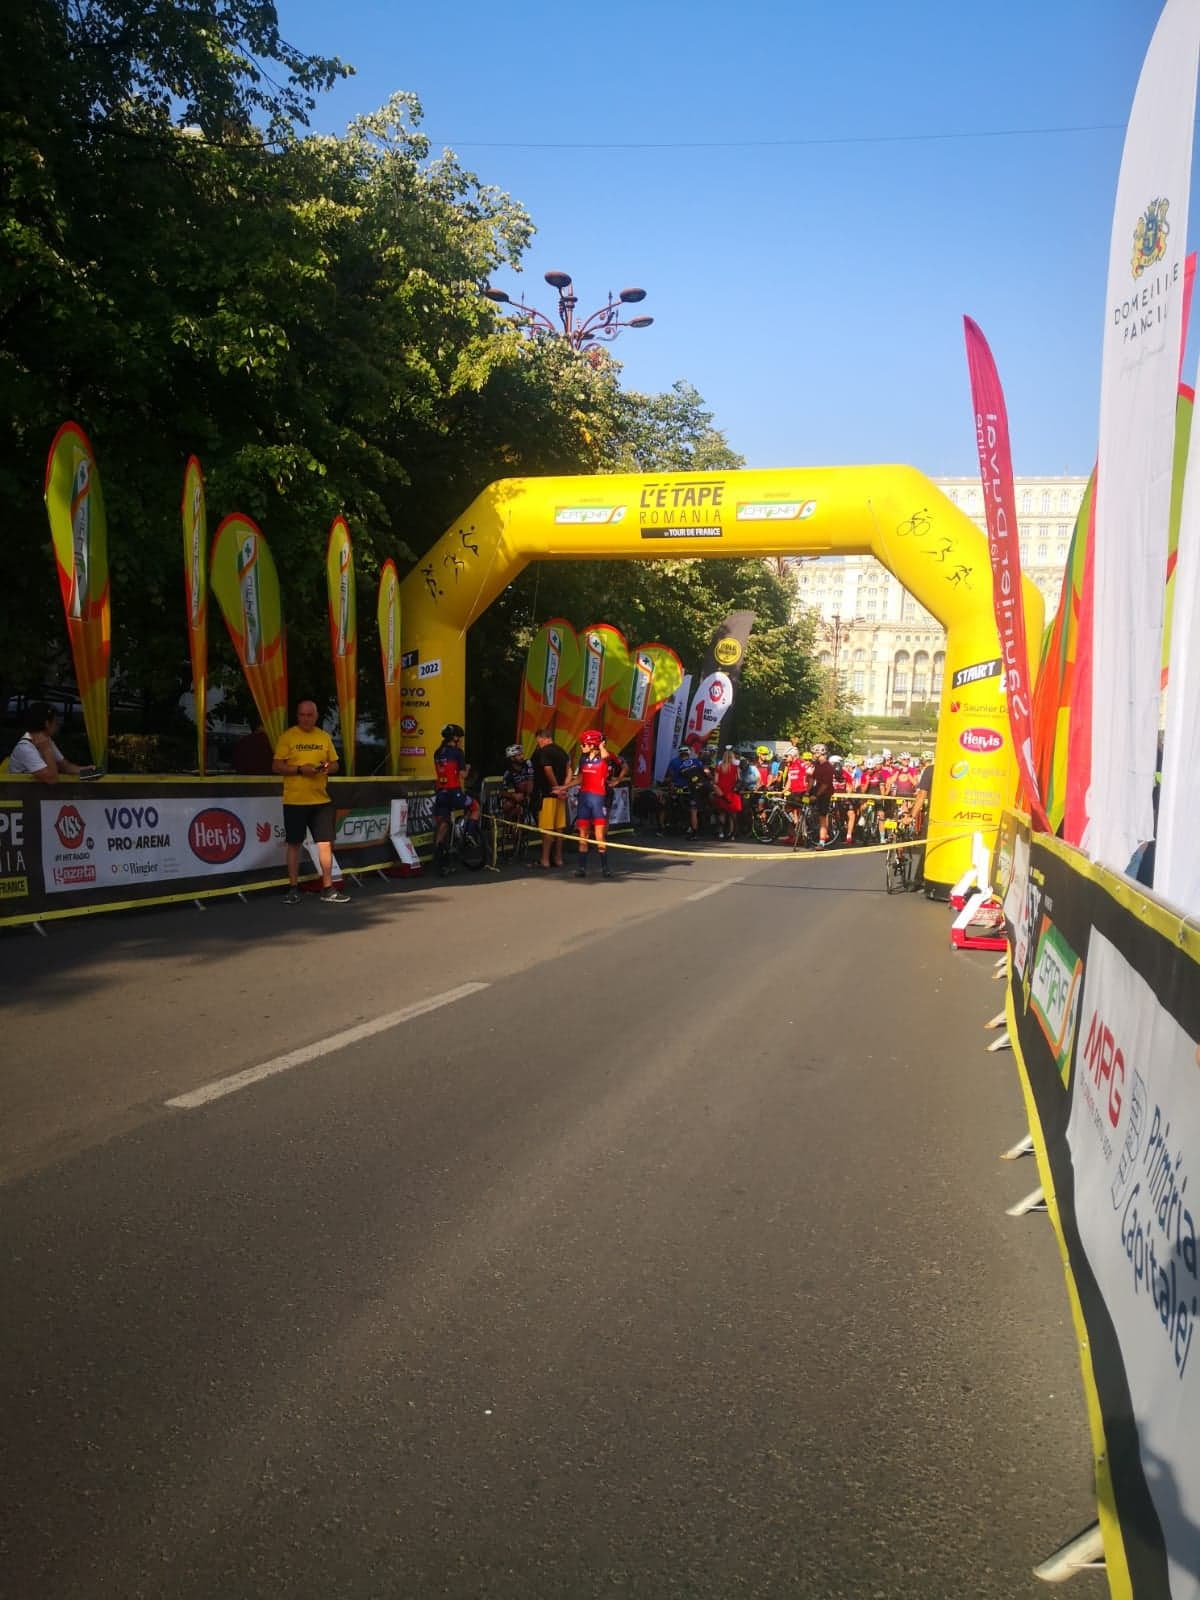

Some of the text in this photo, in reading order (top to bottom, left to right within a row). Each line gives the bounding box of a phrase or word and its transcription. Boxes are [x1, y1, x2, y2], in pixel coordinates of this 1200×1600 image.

[639, 510, 722, 524] ROMANIA
[669, 528, 686, 536] TOUR
[686, 528, 695, 536] DE
[695, 527, 721, 536] FRANCE
[420, 663, 439, 676] 2022
[956, 661, 996, 686] START
[963, 702, 998, 713] Saunier
[963, 730, 1000, 748] Hervis
[104, 806, 159, 830] VOYO
[953, 811, 993, 822] MPG
[107, 836, 132, 850] PRO
[135, 833, 171, 849] ARENA
[195, 822, 241, 851] Hervis
[129, 861, 159, 875] Ringier
[1083, 1009, 1125, 1129] MPG
[1121, 1183, 1197, 1381] Capitalei
